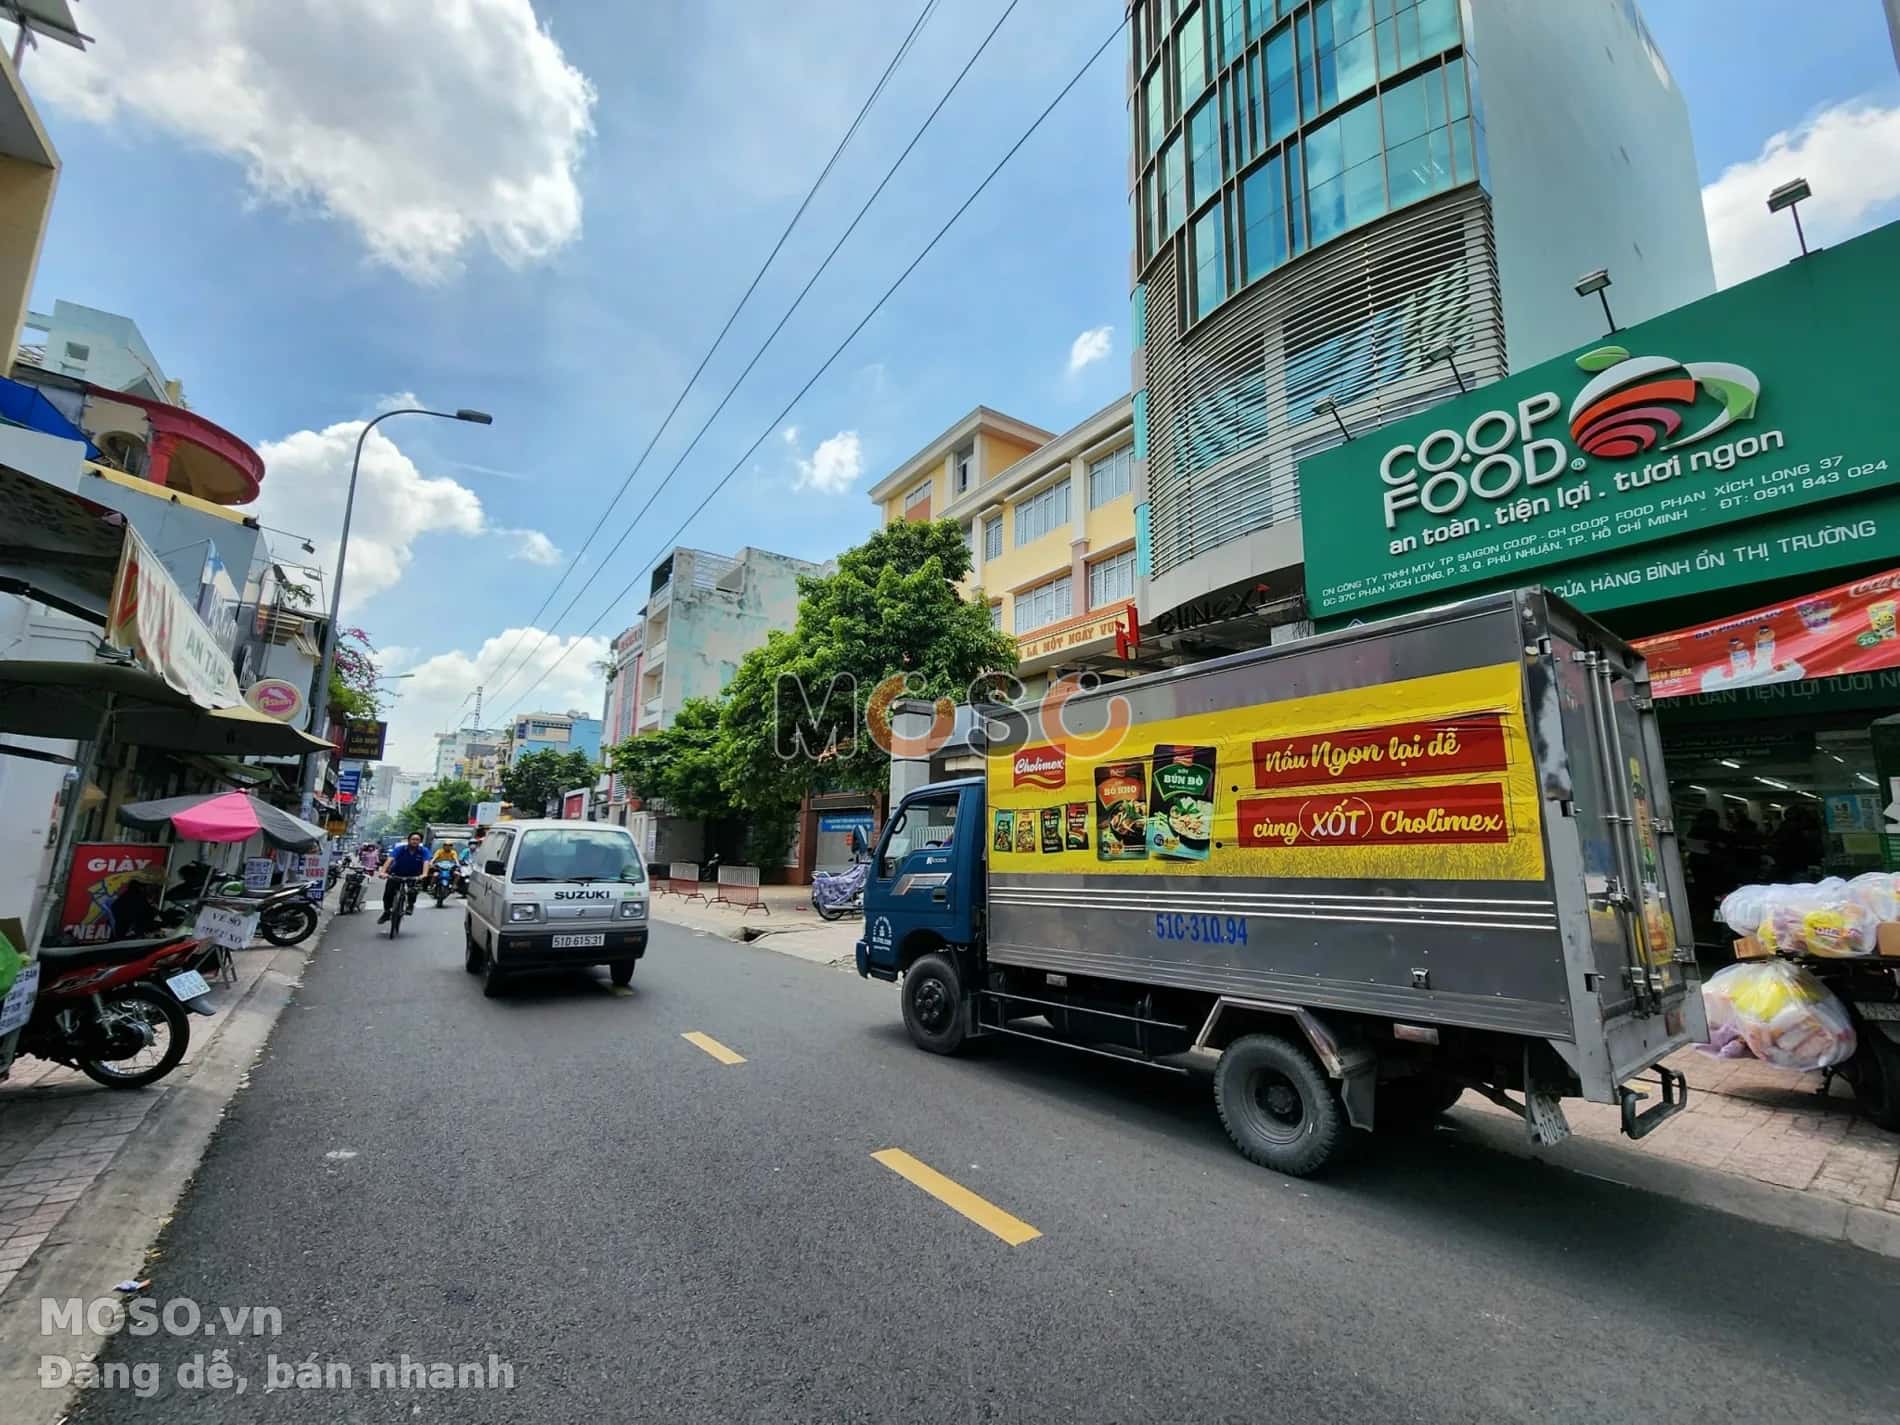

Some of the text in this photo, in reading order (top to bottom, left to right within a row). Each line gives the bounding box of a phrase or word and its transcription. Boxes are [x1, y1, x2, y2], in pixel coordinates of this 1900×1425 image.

[1379, 391, 1561, 487] CO.OP
[1383, 438, 1569, 529] FOOD
[1389, 429, 1784, 555] an toàn tiện lợi tươi ngon
[1358, 584, 1385, 600] PHAN
[1389, 575, 1412, 592] XÍCH
[1487, 547, 1511, 565] PHÚ
[1591, 524, 1612, 541] HỒ
[1618, 516, 1641, 534] CHÍ
[1648, 509, 1688, 526] MINH
[1753, 482, 1795, 501] 0911
[1802, 473, 1840, 490] 843
[1847, 460, 1888, 478] 024
[1364, 575, 1378, 586] TY
[1383, 567, 1409, 581] TNHH
[1411, 561, 1436, 575] MTV
[1439, 555, 1454, 566] TP
[1457, 544, 1500, 562] SAIGON
[1503, 534, 1537, 550] CO.OP
[1547, 527, 1567, 539] CH
[1570, 516, 1609, 534] CO.OP
[1615, 504, 1654, 522] FOOD
[1660, 490, 1706, 508] PHAN
[1714, 477, 1754, 497] XÍCH
[1761, 464, 1810, 484] LONG
[1819, 455, 1844, 469] 37
[1590, 570, 1641, 592] HÀNG
[1647, 558, 1690, 580] BÌNH
[1696, 549, 1725, 571] ỔN
[1734, 542, 1768, 562] THỊ
[1777, 519, 1877, 553] TRƯỜNG
[1015, 757, 1065, 774] Cholimex
[1265, 727, 1461, 776] Nấu Ngon lại dễ
[87, 855, 152, 872] GIÀY
[1253, 817, 1301, 846] cùng
[1380, 808, 1503, 835] Cholimex
[554, 890, 610, 900] SUZUKI
